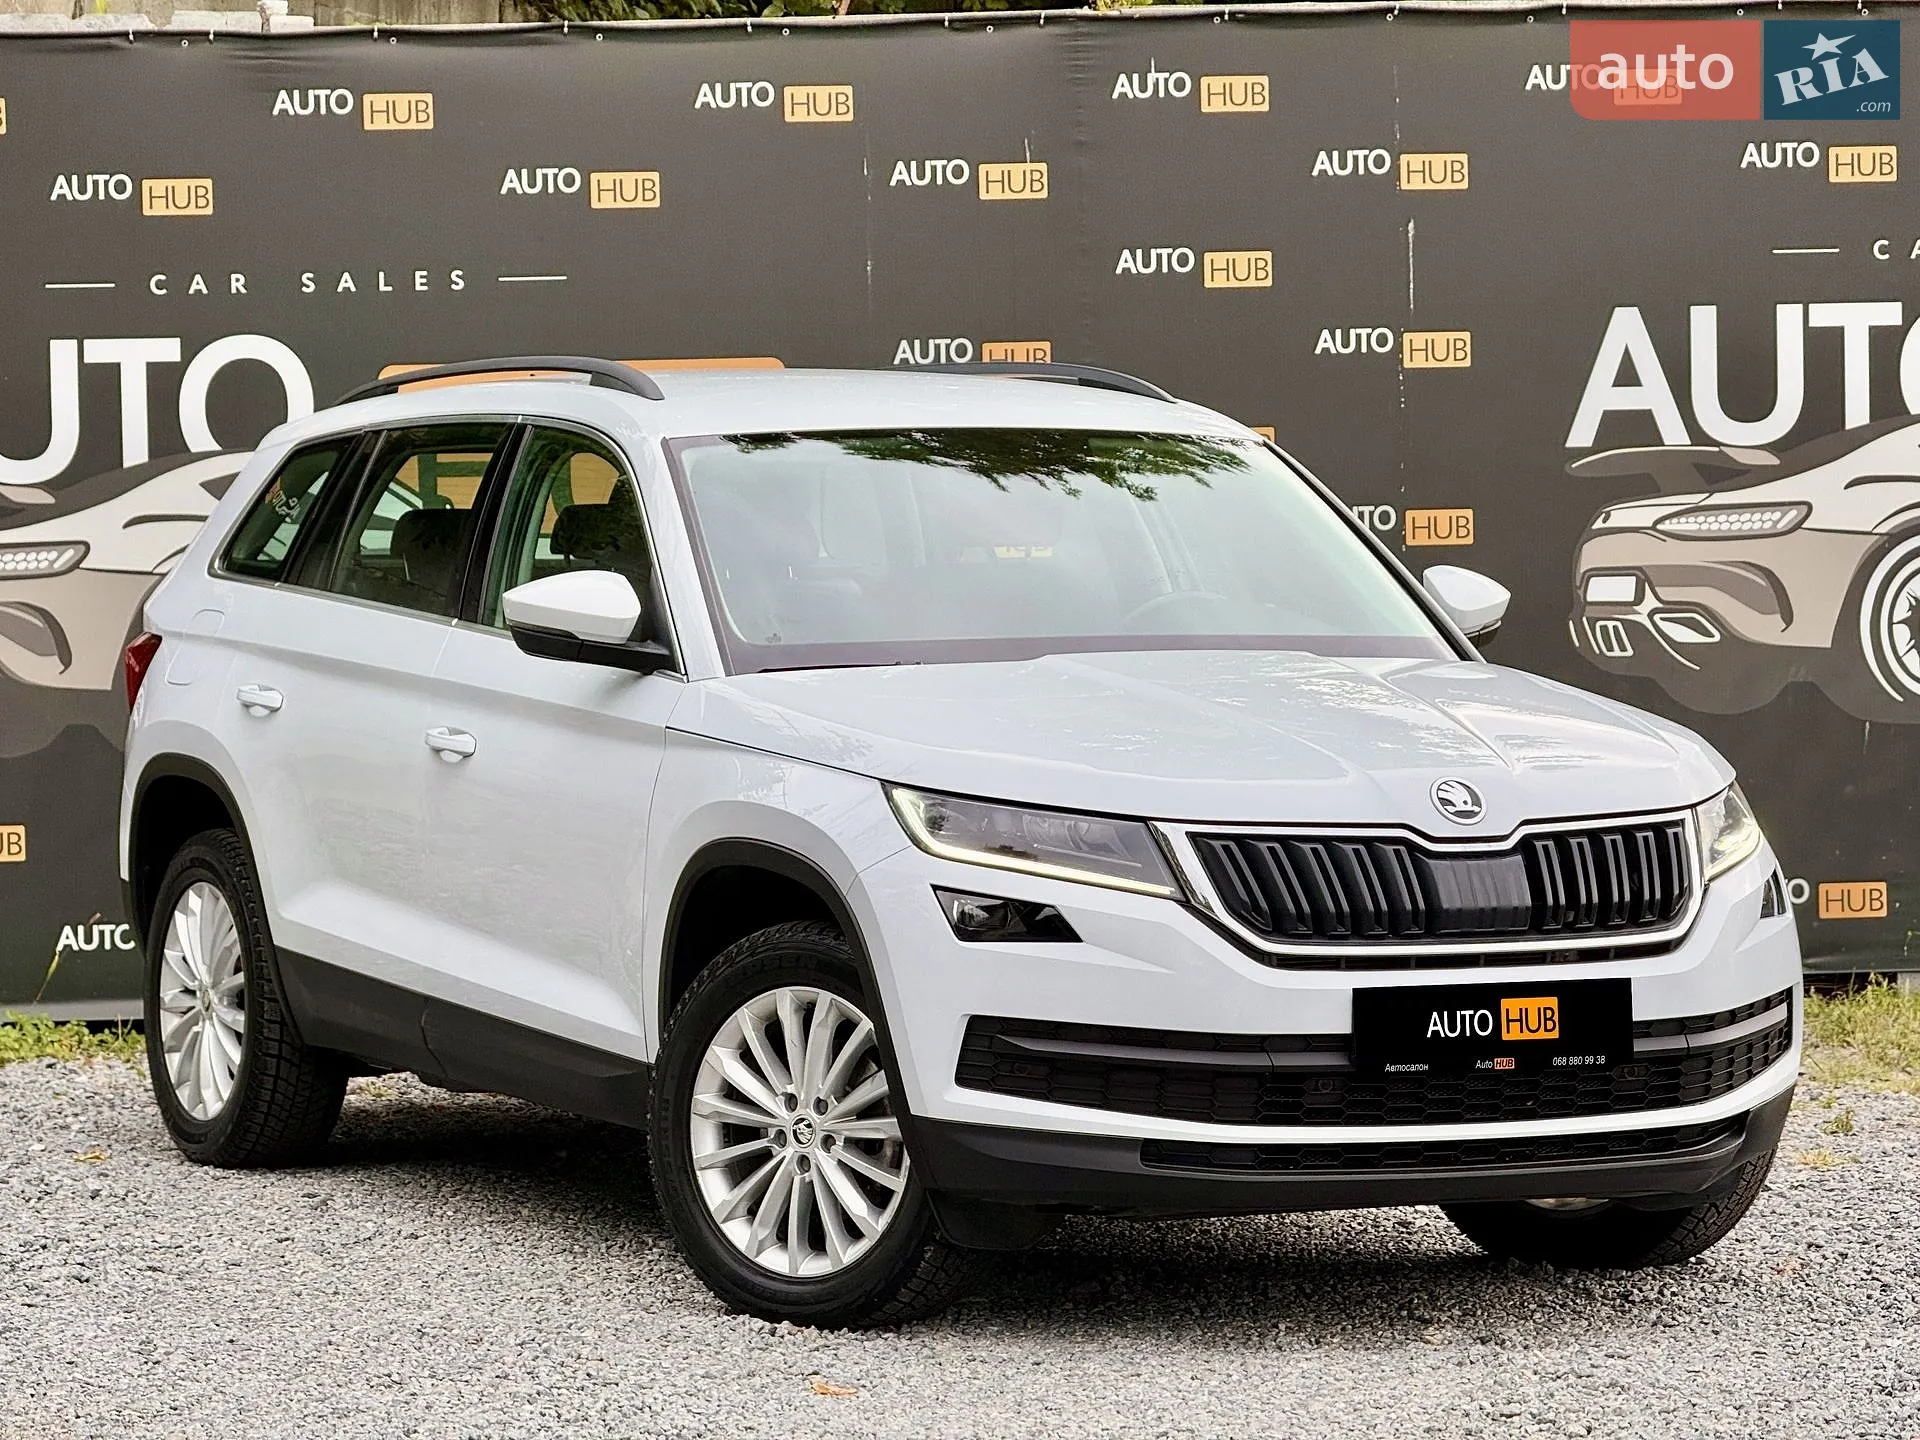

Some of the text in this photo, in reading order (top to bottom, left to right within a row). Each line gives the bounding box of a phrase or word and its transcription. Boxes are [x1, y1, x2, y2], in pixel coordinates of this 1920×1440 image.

[272, 88, 430, 125] AUTO HUB
[694, 81, 850, 117] AUTO HUB
[1111, 71, 1266, 107] AUTO HUB
[889, 158, 1045, 194] AUTO HUB
[1311, 148, 1466, 185] AUTO HUB
[1739, 141, 1894, 177] AUTO HUB
[50, 173, 210, 210] AUTO HUB
[499, 167, 657, 203] AUTO HUB
[1115, 247, 1269, 283] AUTO HUB
[1873, 239, 1920, 259] CA
[149, 269, 465, 296] CAR SALES
[893, 337, 974, 365] AUTO
[1314, 327, 1468, 363] AUTO HUB
[1565, 301, 1920, 447] AUT
[0, 334, 316, 486] UTO
[1352, 504, 1471, 541] TO HUB
[1825, 888, 1884, 913] HUB
[1426, 1006, 1557, 1038] AUTO HUB
[1475, 1059, 1514, 1069] Auto HUB
[1552, 1056, 1567, 1066] 068
[1584, 1055, 1595, 1065] 99
[1595, 1055, 1606, 1065] 38
